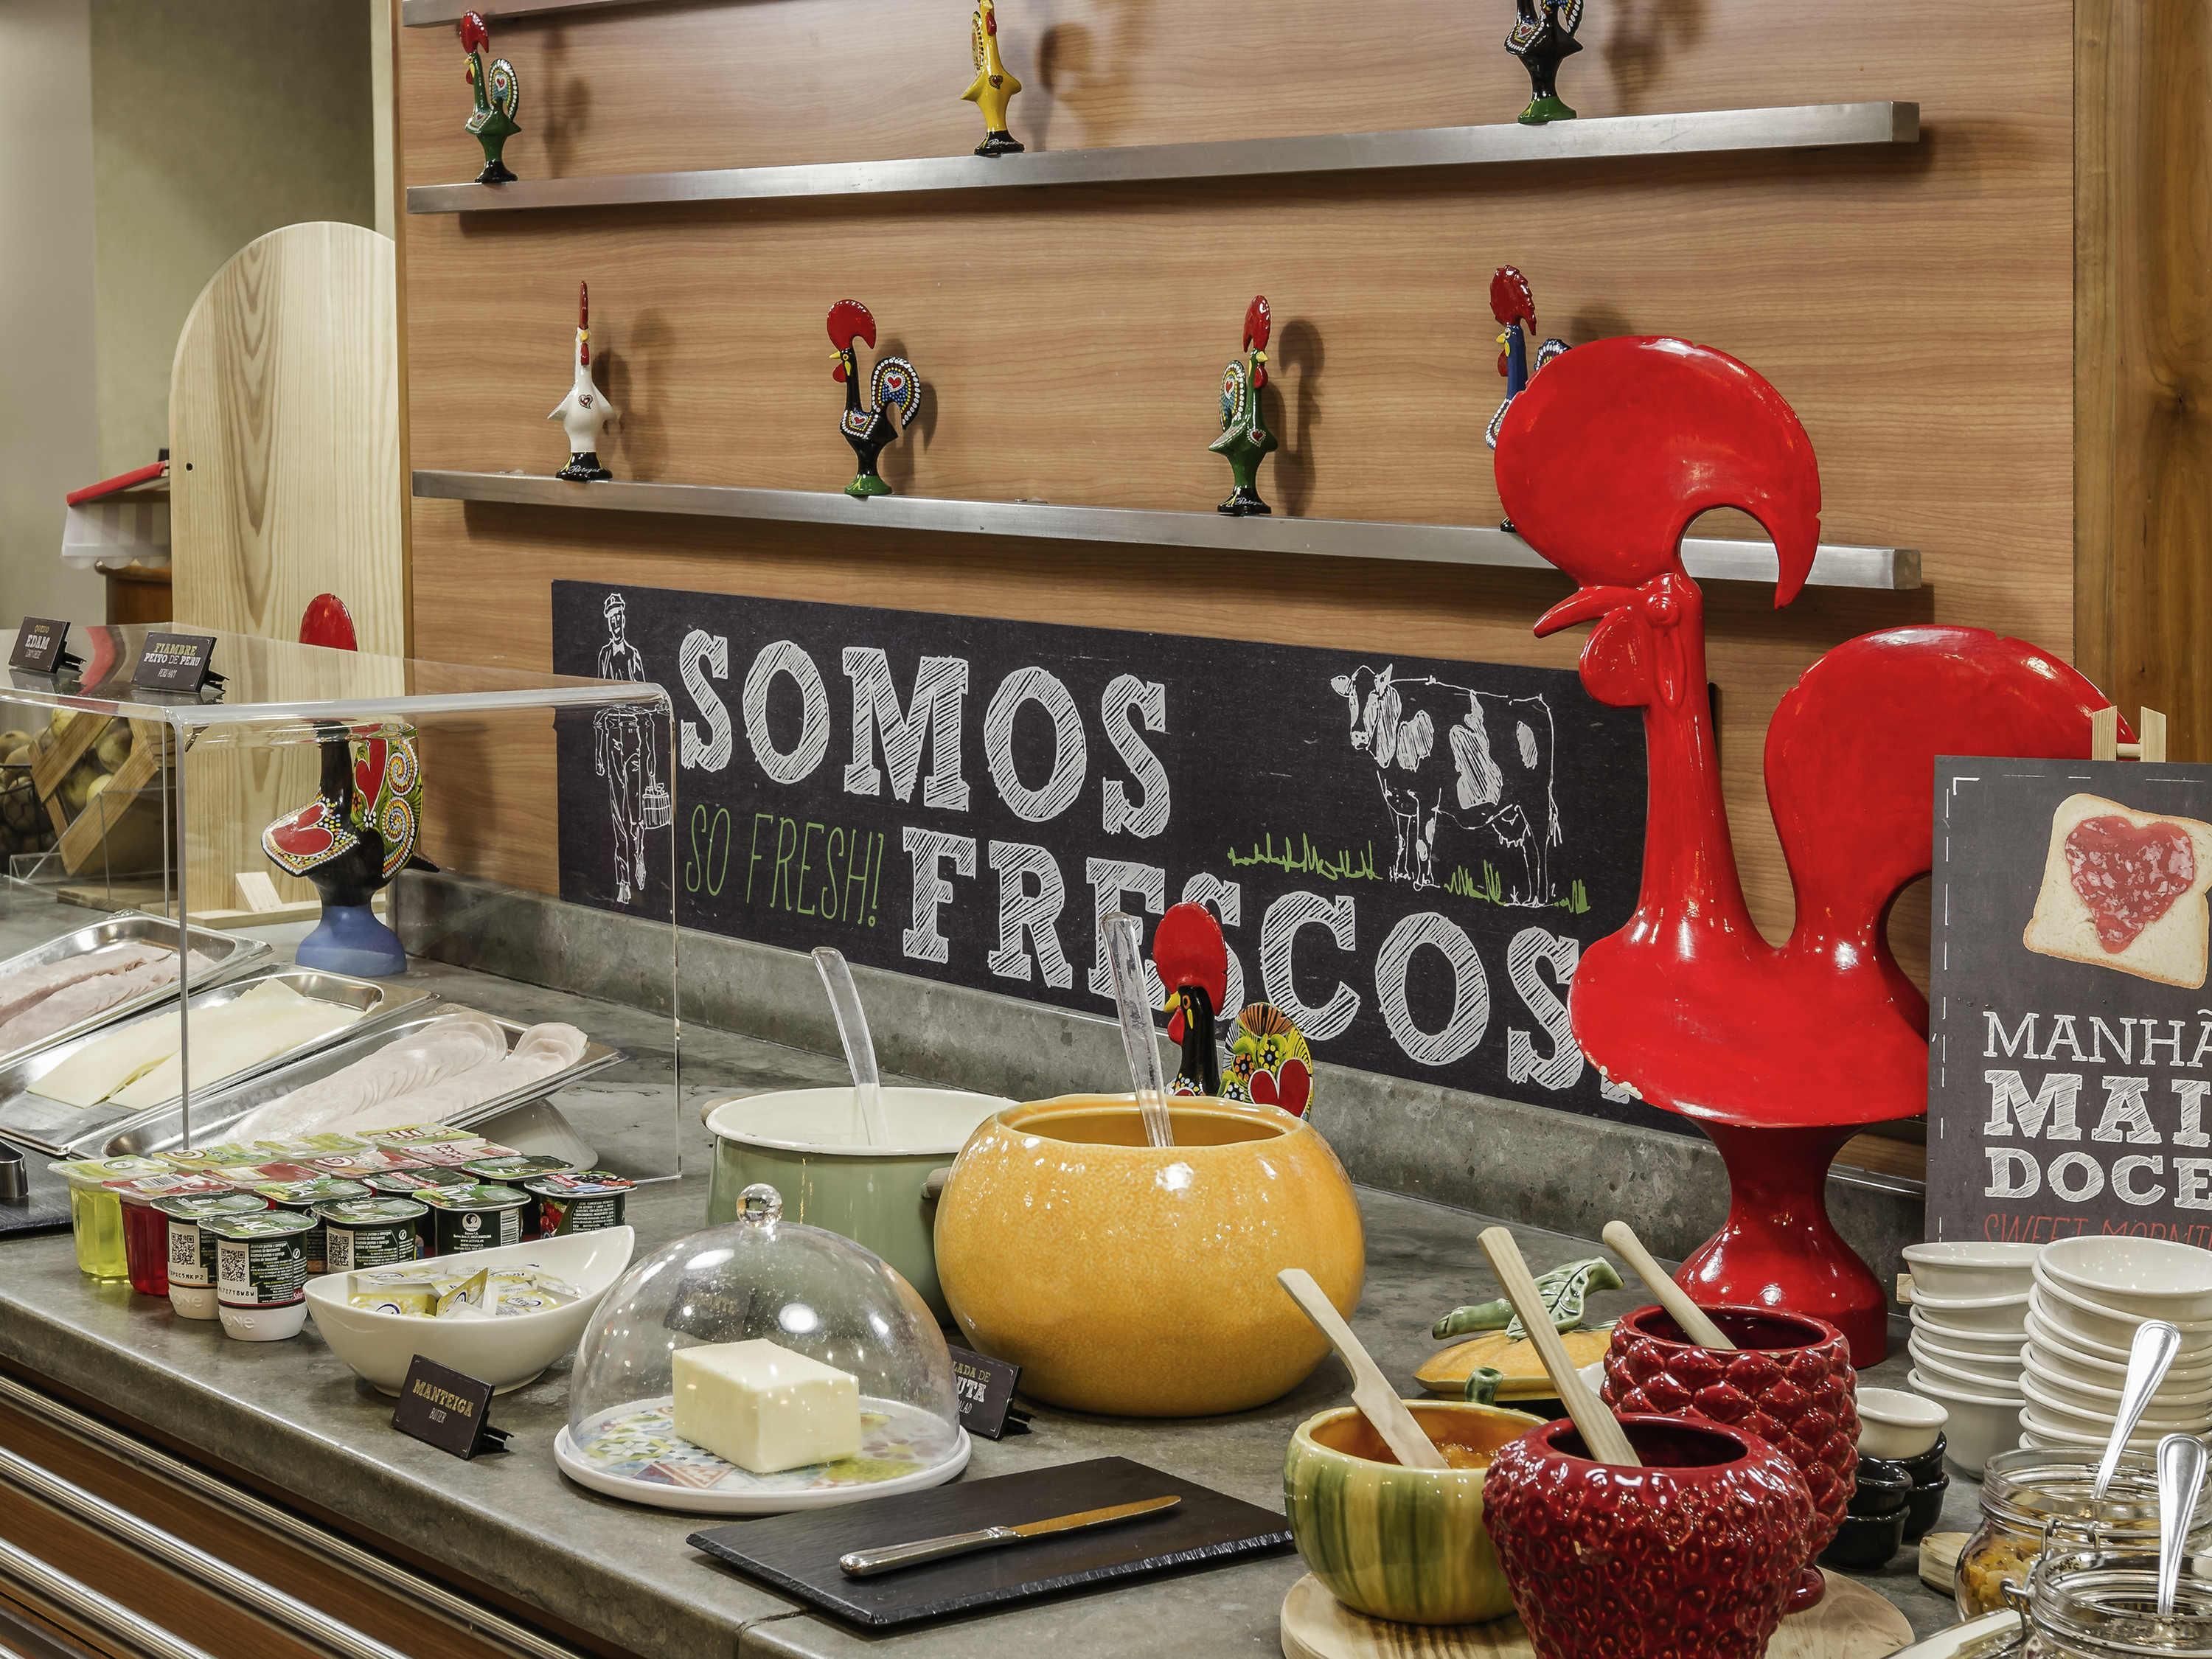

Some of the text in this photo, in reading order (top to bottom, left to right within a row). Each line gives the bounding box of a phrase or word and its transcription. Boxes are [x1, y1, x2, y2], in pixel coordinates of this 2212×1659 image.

[24, 634, 51, 650] EDAM
[153, 642, 198, 656] FIAMBRE
[143, 653, 201, 667] PEITO DE PERU
[679, 628, 1172, 839] SOMOS
[686, 803, 885, 928] SO FRESH!
[902, 827, 1630, 1104] FRESCOS
[1983, 1146, 2212, 1211] DOCE
[953, 1361, 991, 1383] LADA DE
[413, 1380, 474, 1417] MANTEIGA
[956, 1377, 986, 1402] UTA
